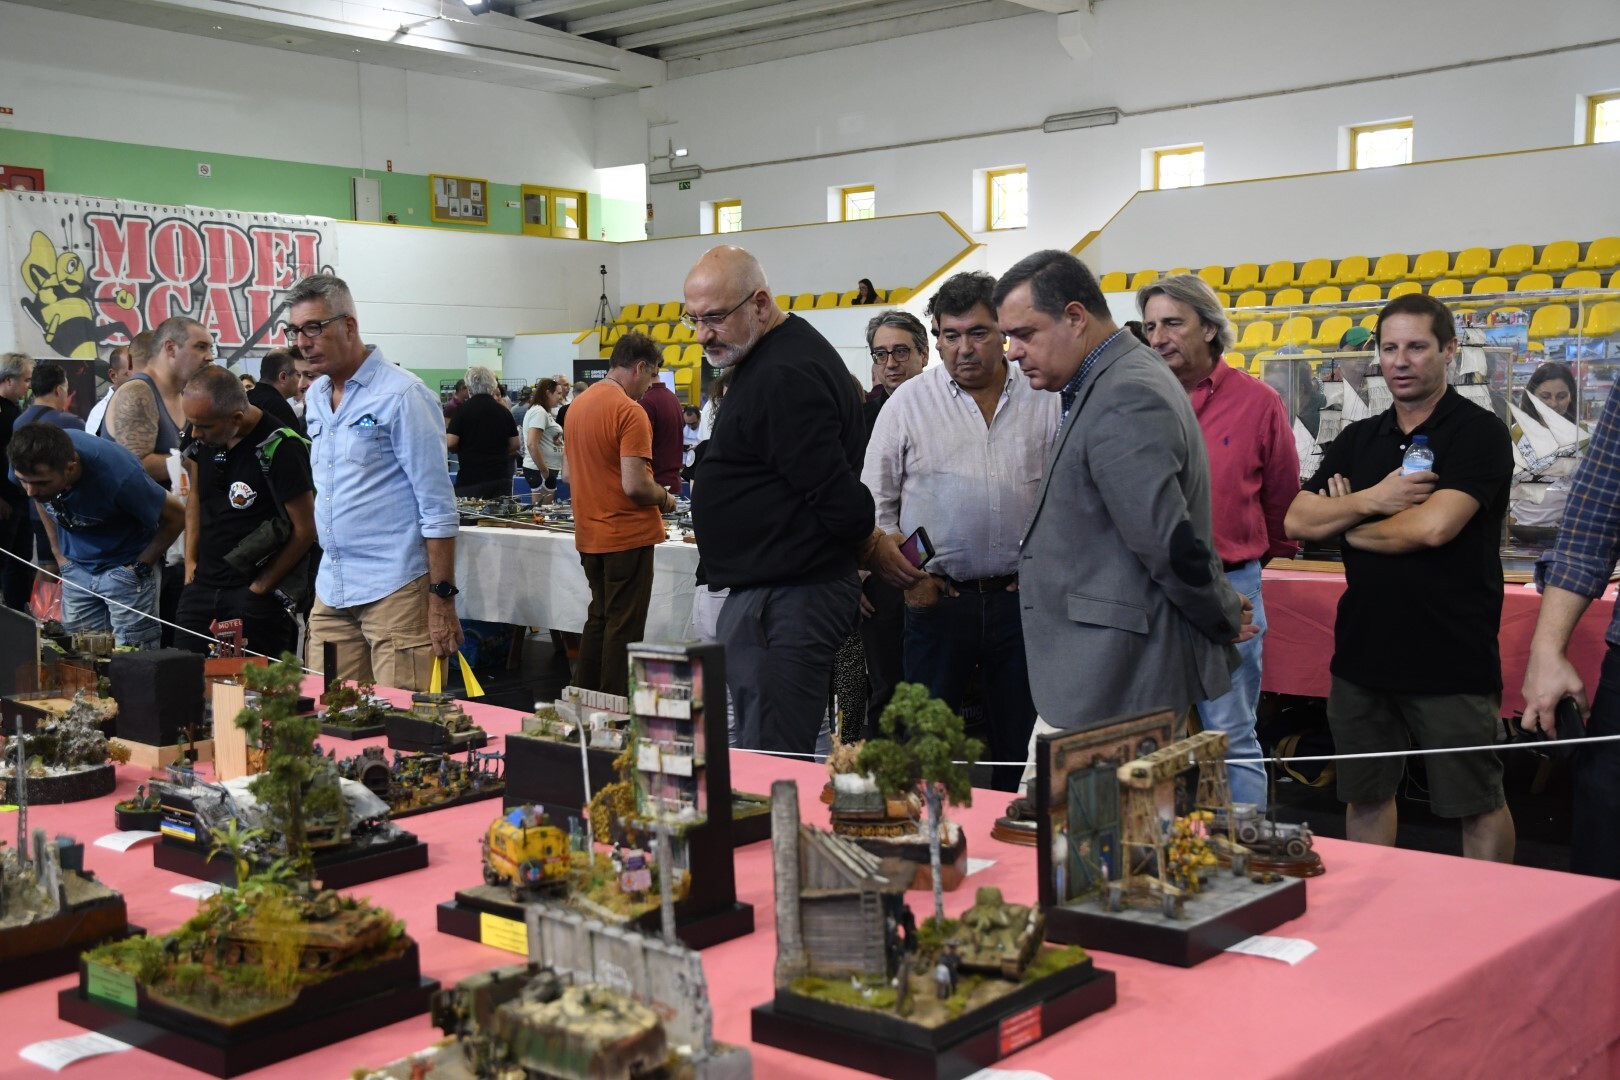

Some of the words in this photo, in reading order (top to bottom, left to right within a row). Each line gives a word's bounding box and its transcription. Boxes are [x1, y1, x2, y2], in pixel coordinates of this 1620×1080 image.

[17, 194, 101, 208] CONCURSO
[87, 214, 320, 291] MODEL
[94, 280, 297, 347] SCAL
[218, 620, 243, 630] MOTEL
